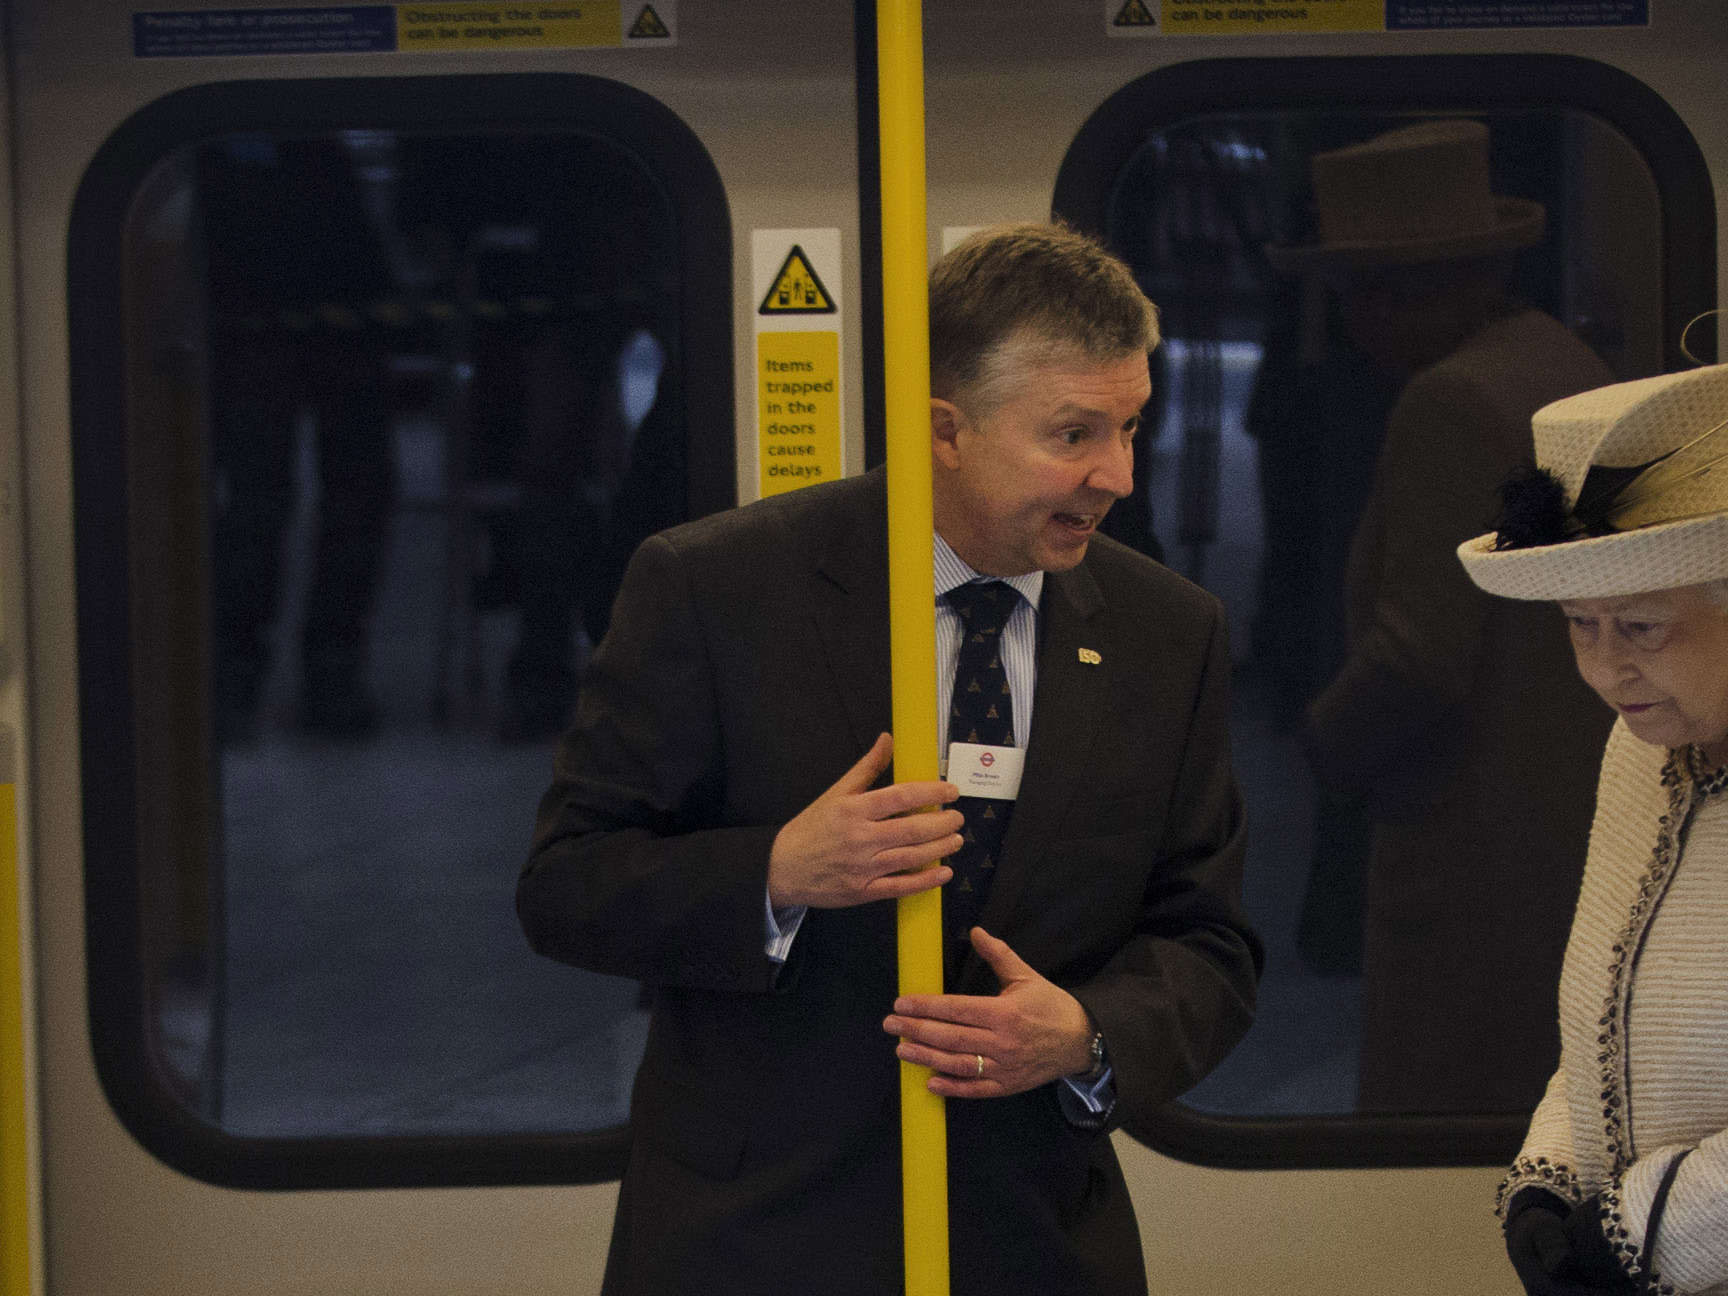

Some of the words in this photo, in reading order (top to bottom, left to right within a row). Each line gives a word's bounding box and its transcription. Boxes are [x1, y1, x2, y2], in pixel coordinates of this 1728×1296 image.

[262, 12, 355, 28] prosecution
[406, 9, 501, 24] Obstructing
[505, 9, 532, 20] the
[537, 7, 582, 20] doors
[1171, 11, 1199, 21] can
[1203, 9, 1223, 20] be
[1228, 8, 1308, 22] dangerous
[406, 27, 434, 40] can
[437, 25, 459, 39] be
[465, 24, 544, 41] dangerous
[766, 359, 814, 373] Items
[767, 379, 834, 395] trapped
[767, 400, 782, 414] in
[787, 400, 816, 414] the
[767, 422, 816, 435] doors
[768, 443, 815, 457] cause
[768, 463, 822, 478] delays
